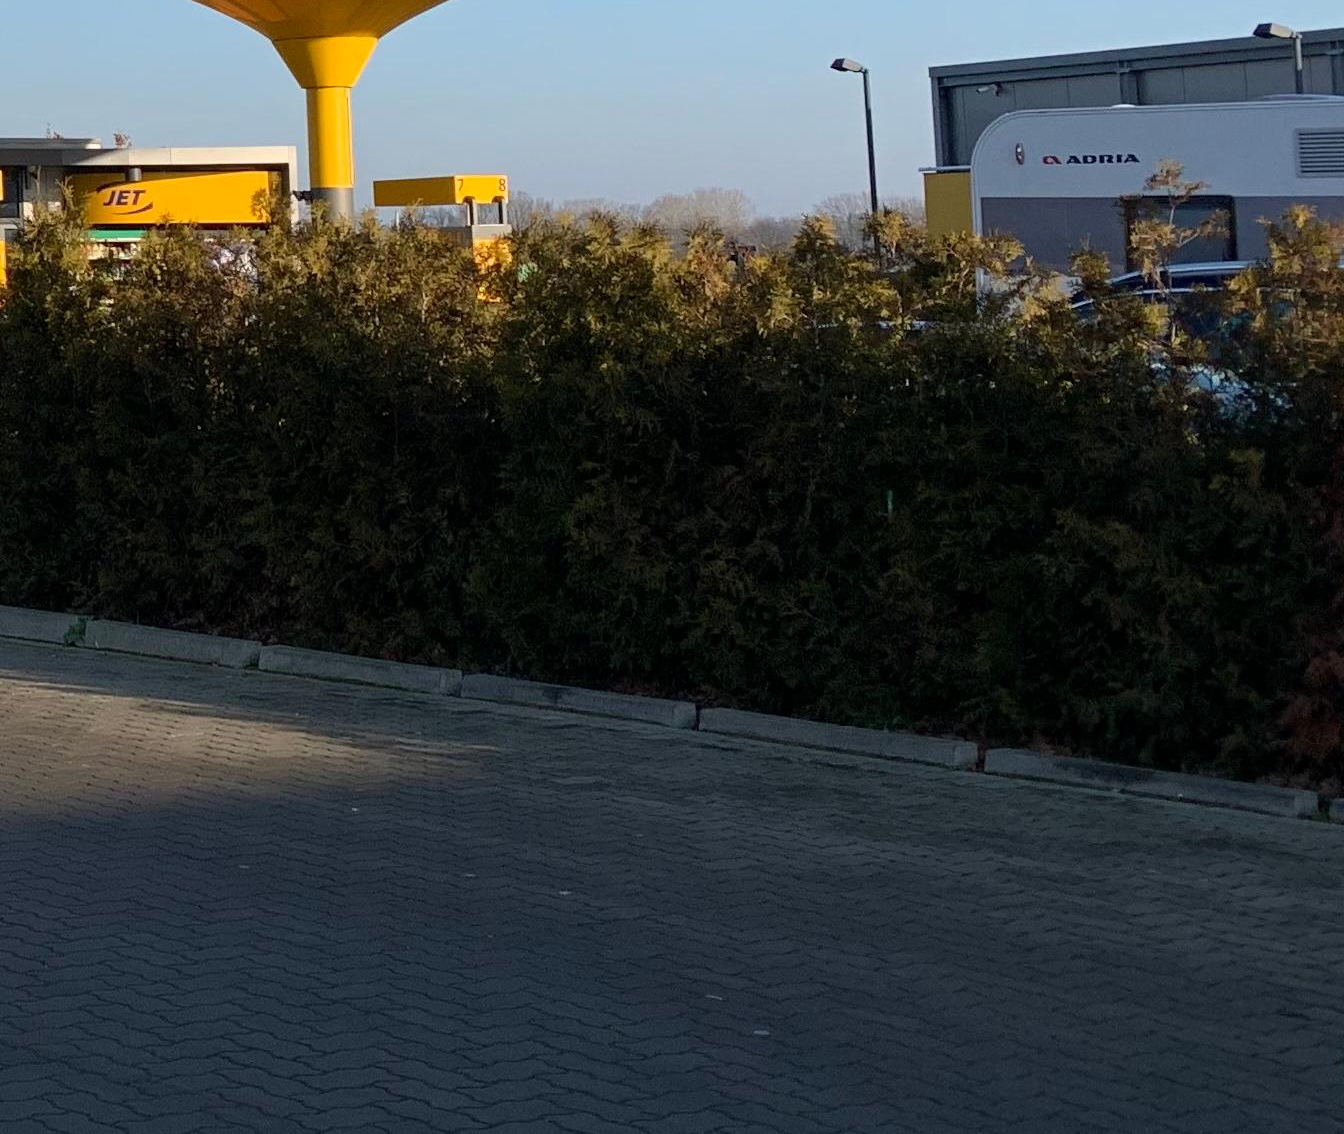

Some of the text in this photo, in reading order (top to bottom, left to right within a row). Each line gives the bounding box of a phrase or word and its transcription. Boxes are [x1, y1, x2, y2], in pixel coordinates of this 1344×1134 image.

[1066, 153, 1140, 165] ADRIA
[457, 178, 506, 192] 7 8
[103, 189, 146, 206] JET
